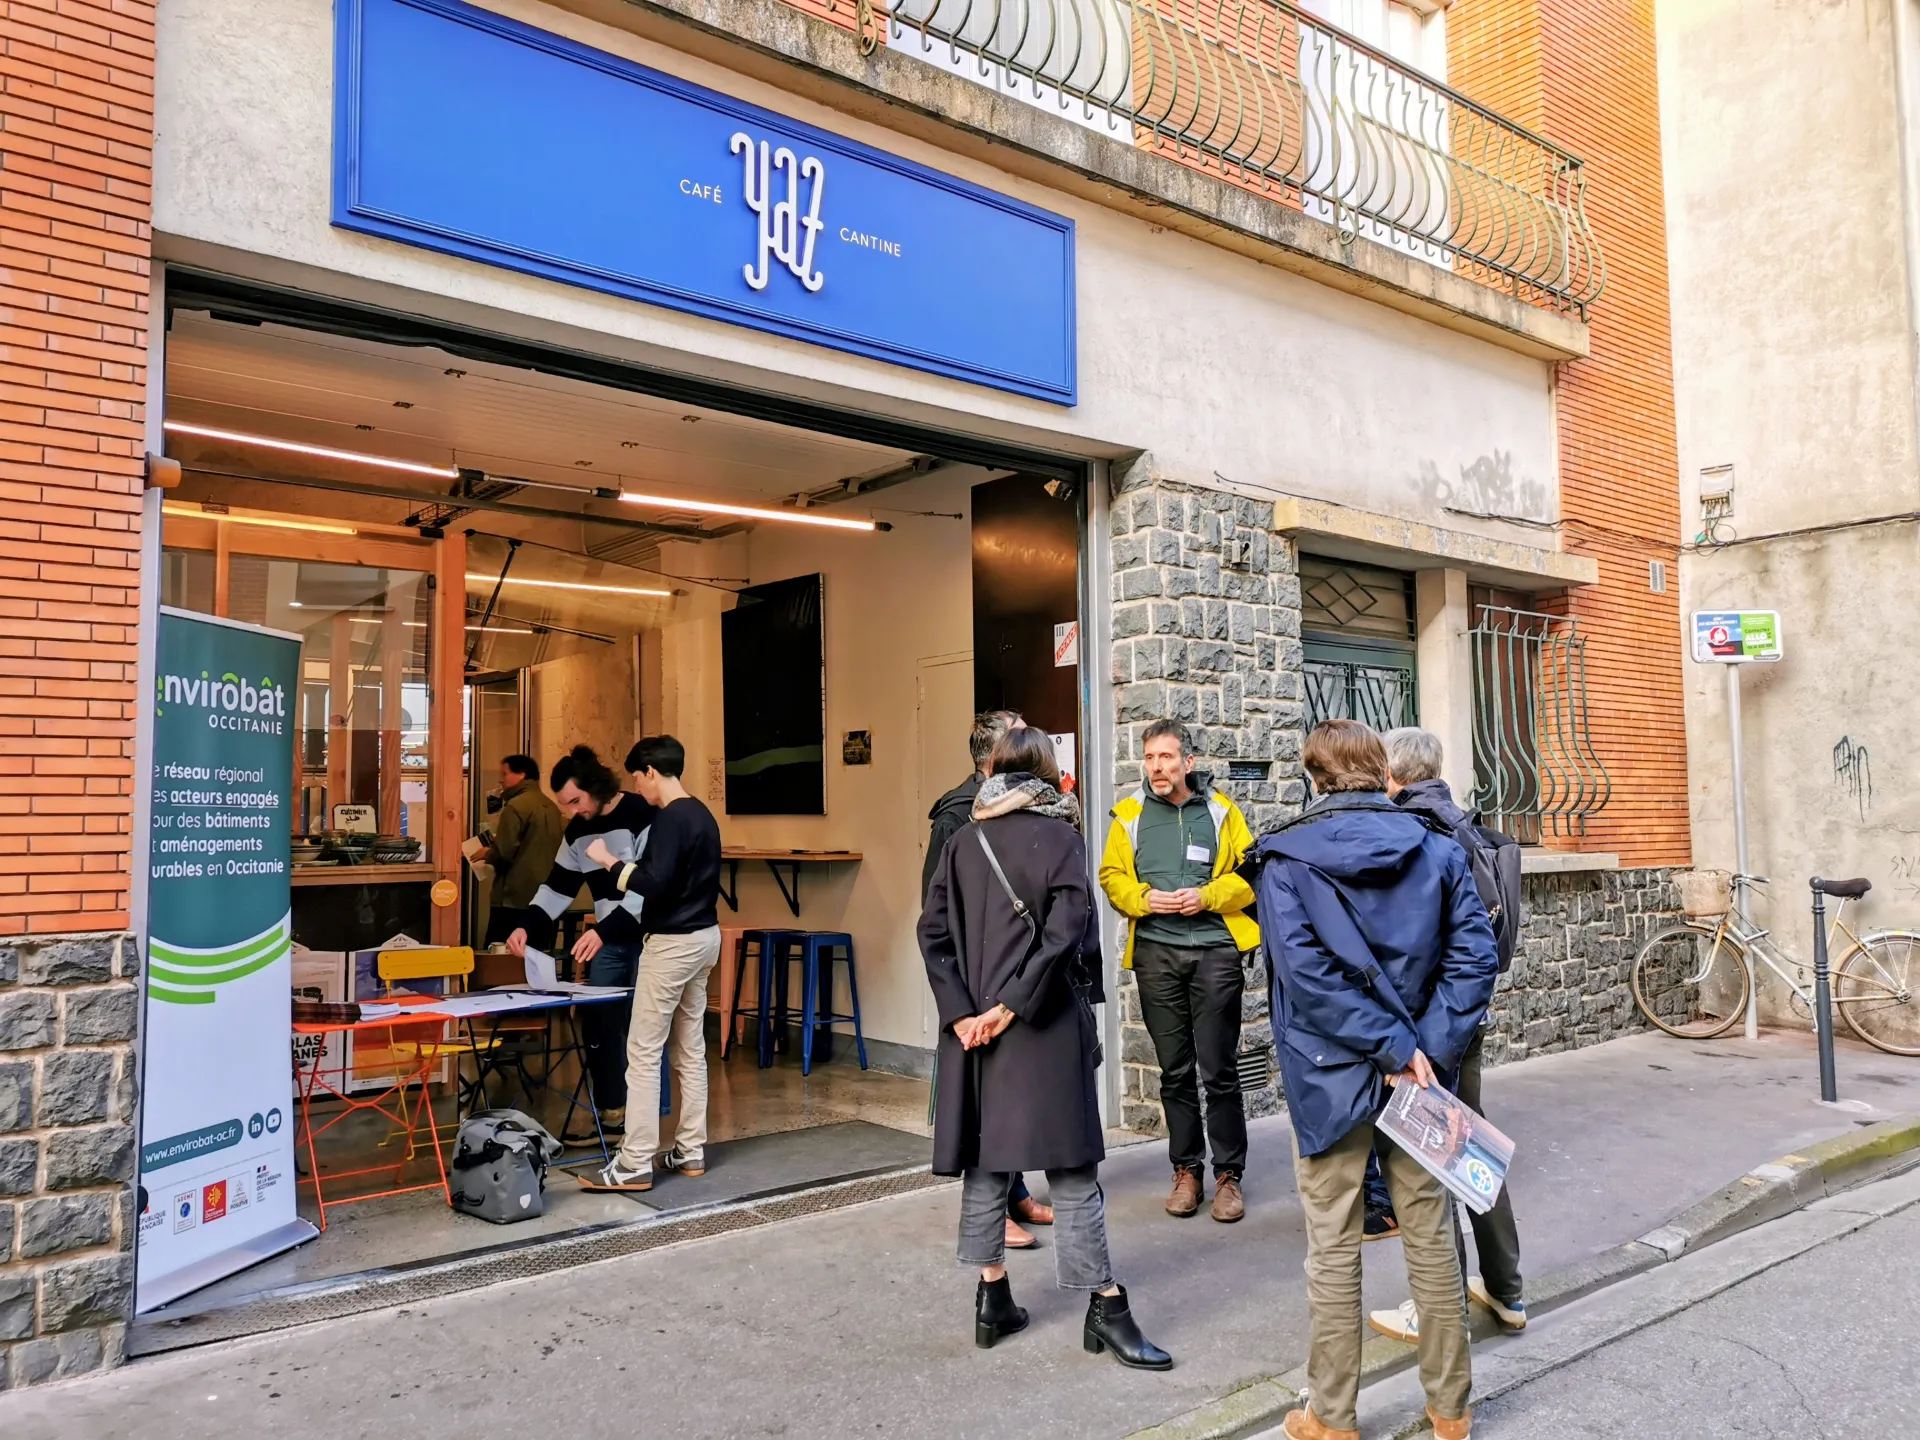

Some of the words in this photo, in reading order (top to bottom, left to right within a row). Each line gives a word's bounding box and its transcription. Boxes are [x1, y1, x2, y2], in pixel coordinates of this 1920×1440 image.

[679, 179, 722, 204] CAFÉ
[839, 227, 901, 257] CANTINE
[208, 714, 283, 735] OCCITANIE
[164, 761, 210, 780] réseau
[214, 766, 263, 785] régional
[171, 789, 222, 804] acteurs
[226, 790, 279, 808] engagés
[177, 812, 201, 828] des
[205, 812, 270, 828] bâtiments
[160, 835, 263, 855] aménagements
[152, 860, 203, 878] urables
[207, 863, 223, 876] en
[226, 858, 284, 875] Occitanie
[292, 1034, 322, 1049] LAS
[145, 1126, 237, 1164] www.envirobat-oc.fr
